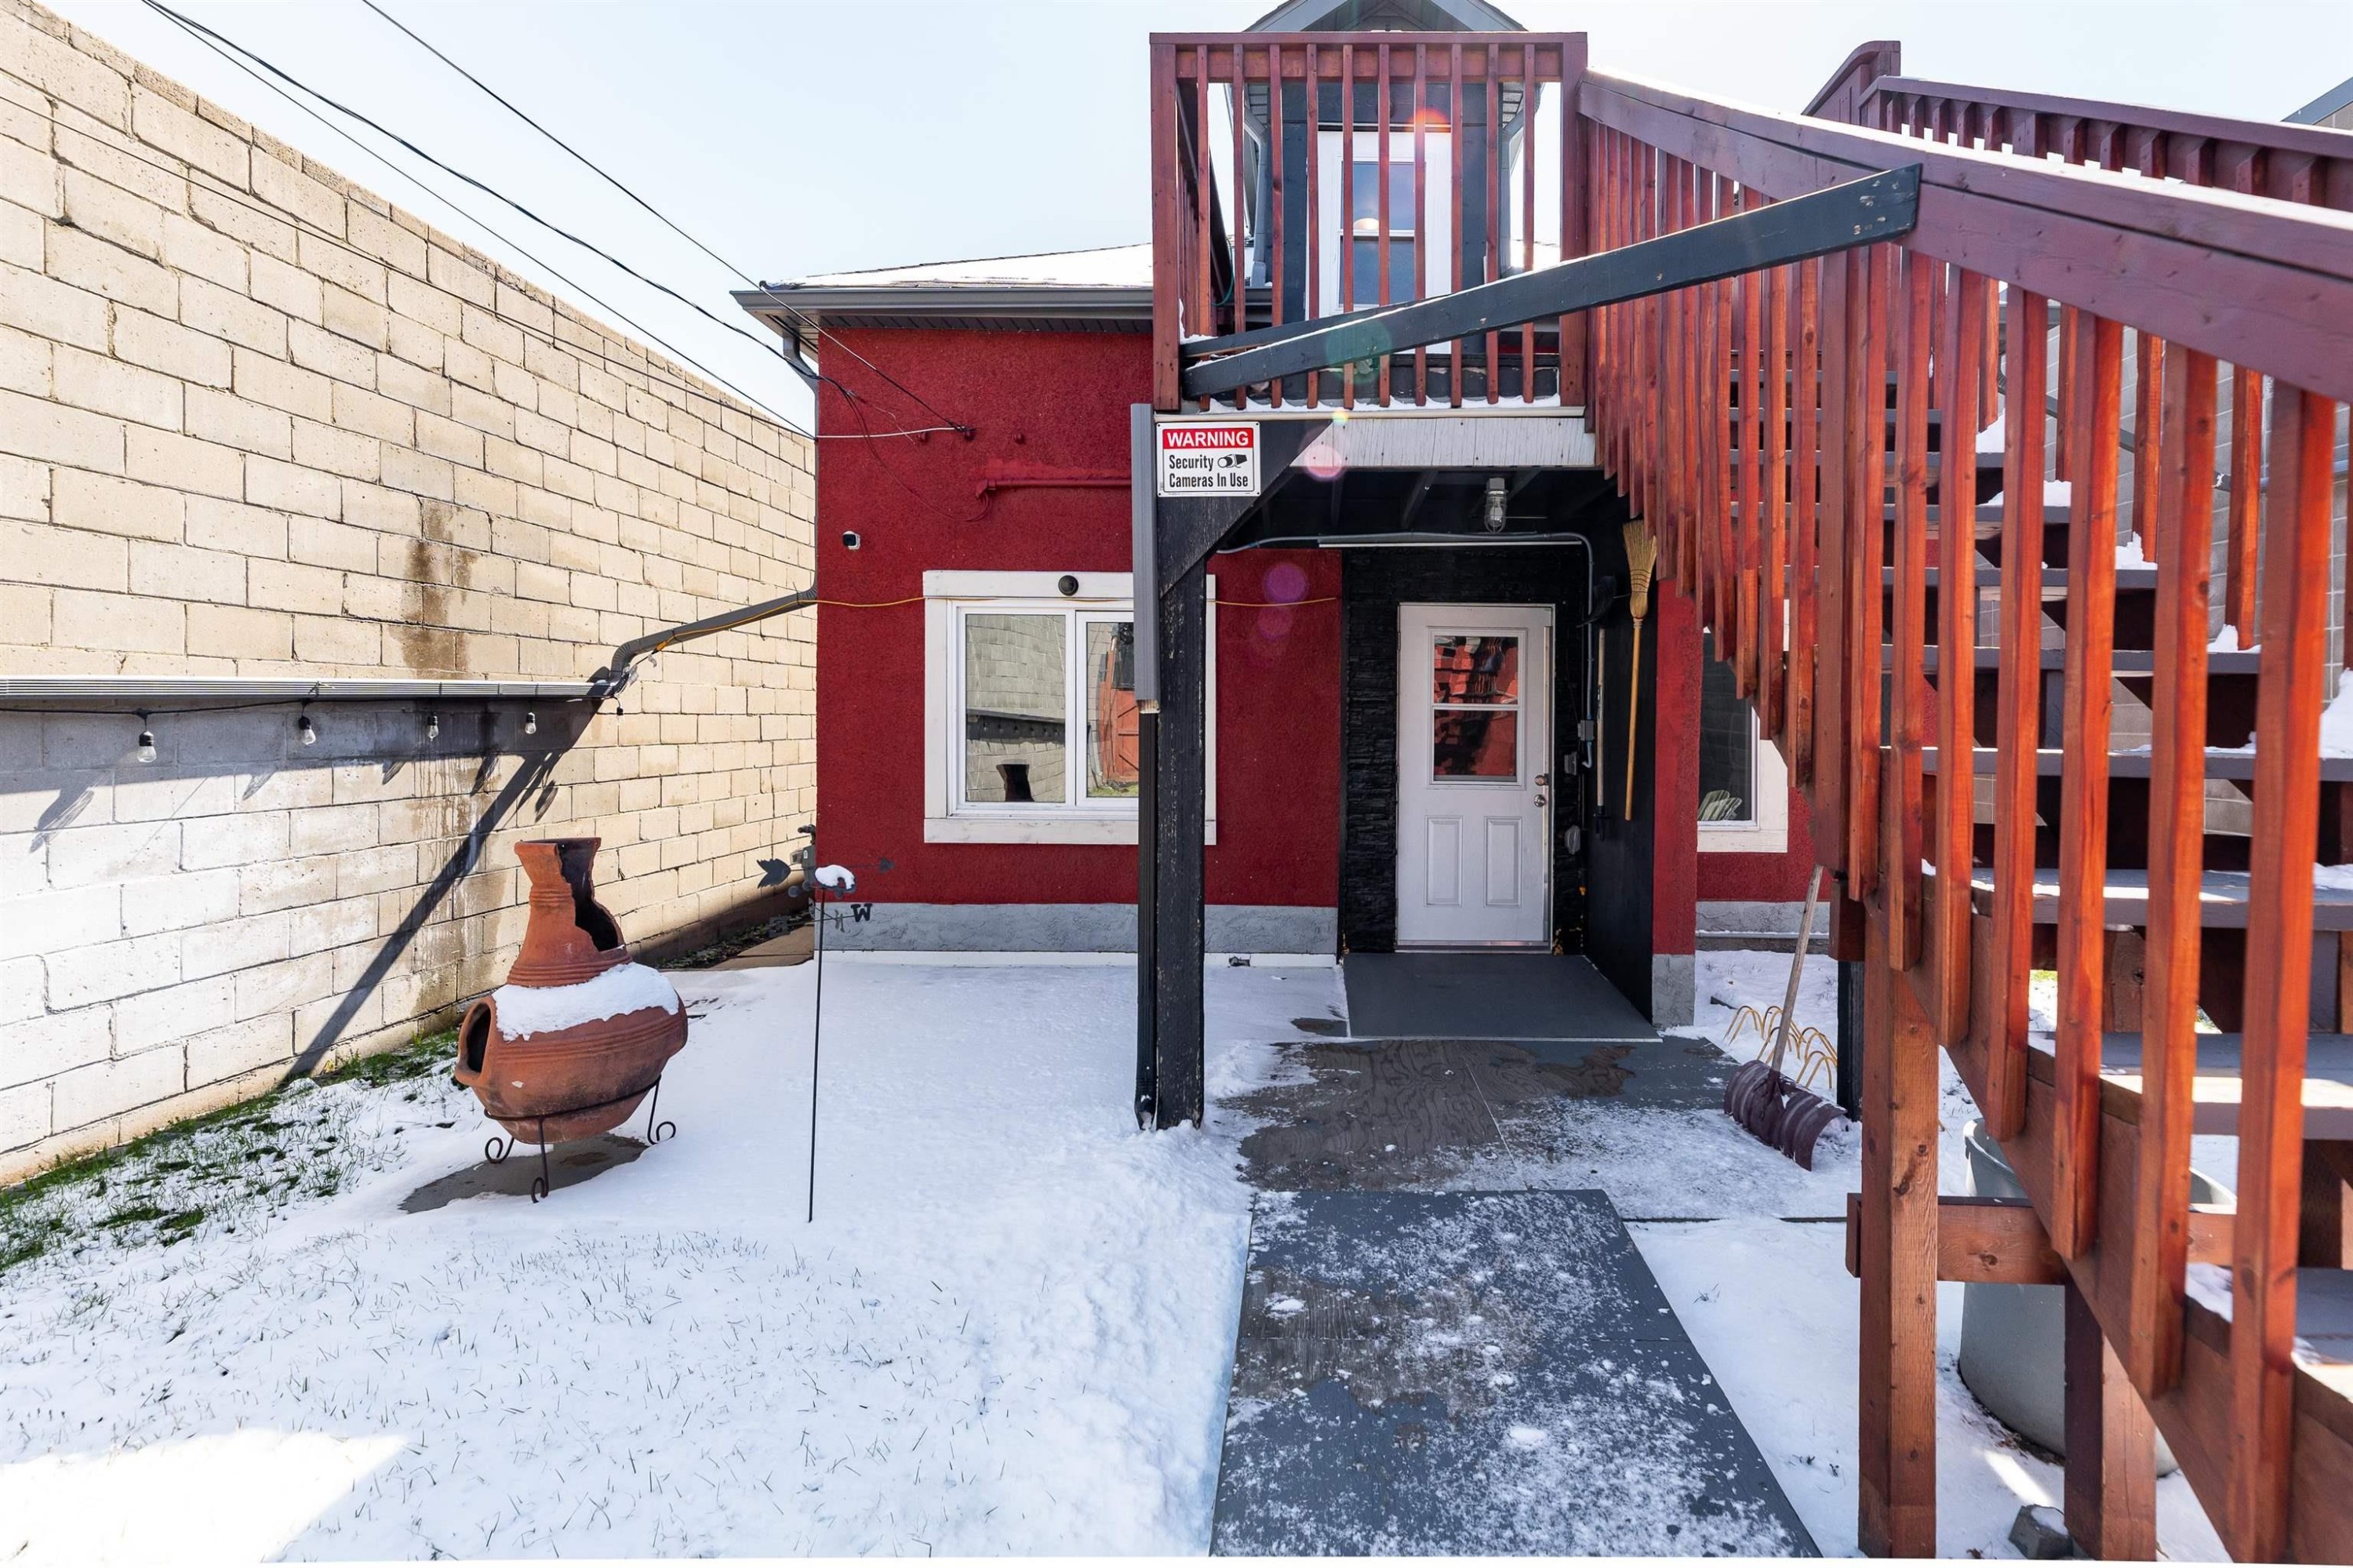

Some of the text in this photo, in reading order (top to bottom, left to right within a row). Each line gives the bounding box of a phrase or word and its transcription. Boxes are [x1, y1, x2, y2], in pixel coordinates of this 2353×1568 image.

[1167, 431, 1249, 446] WARNING
[1169, 454, 1213, 471] Security
[1169, 473, 1213, 487] Cameras
[1217, 473, 1226, 486] In
[1230, 472, 1248, 486] Use
[850, 904, 873, 922] W
